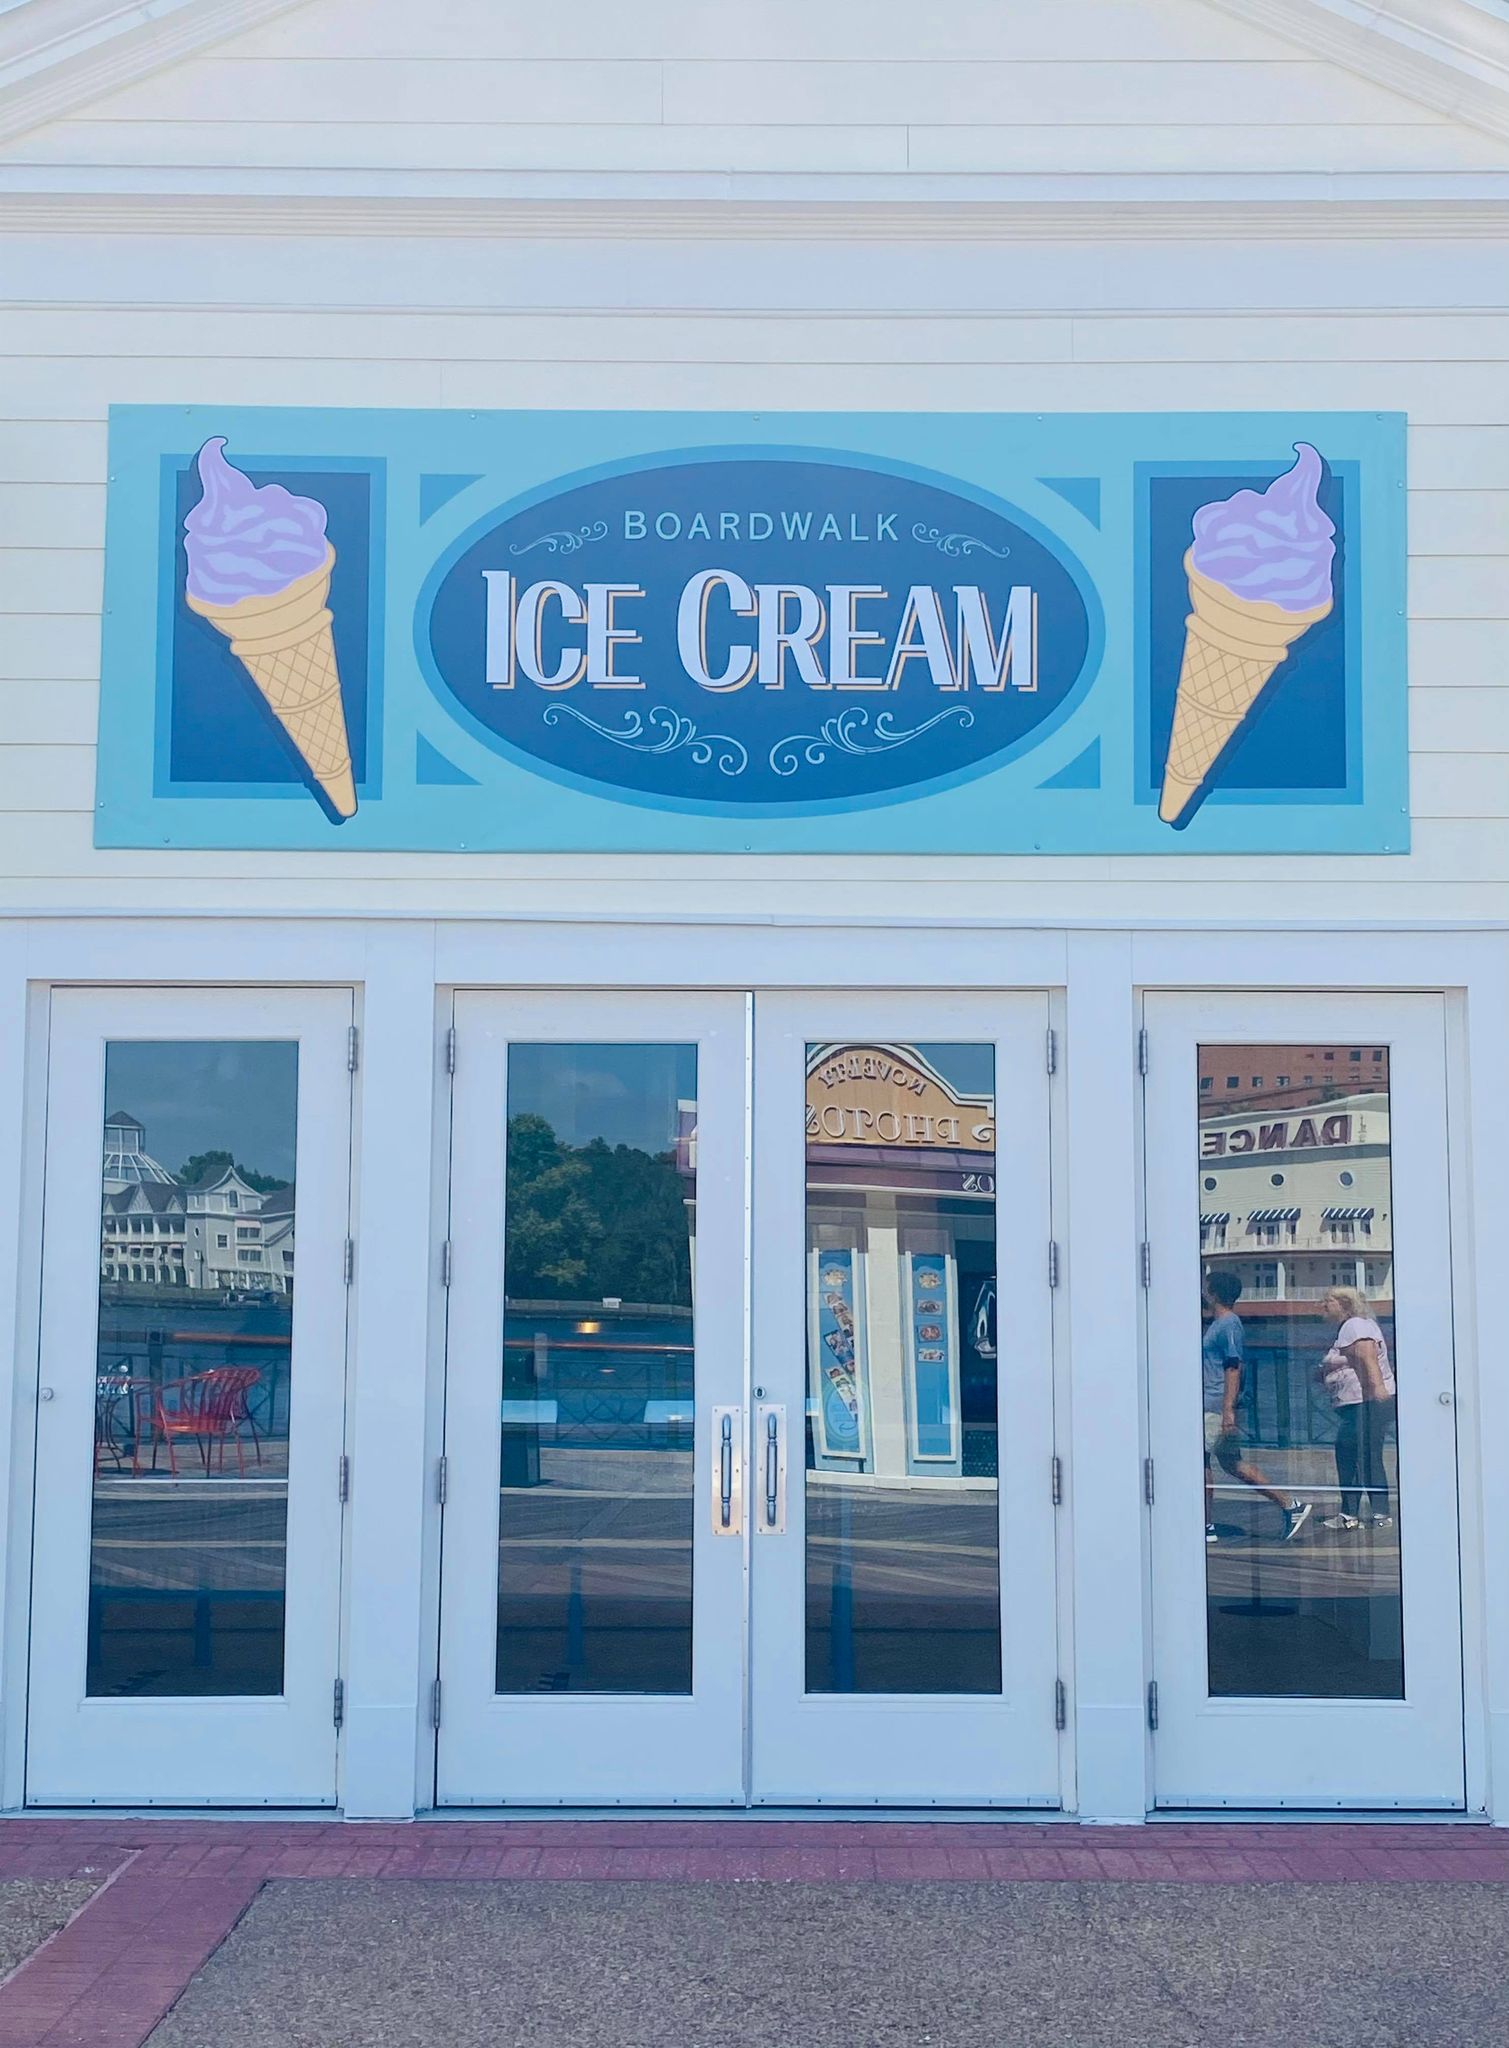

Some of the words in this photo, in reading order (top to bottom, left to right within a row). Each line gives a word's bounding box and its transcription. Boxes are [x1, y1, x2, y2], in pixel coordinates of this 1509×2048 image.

[623, 510, 899, 542] BOARDWALK
[481, 569, 647, 692] ICE
[676, 568, 1039, 694] CREAM
